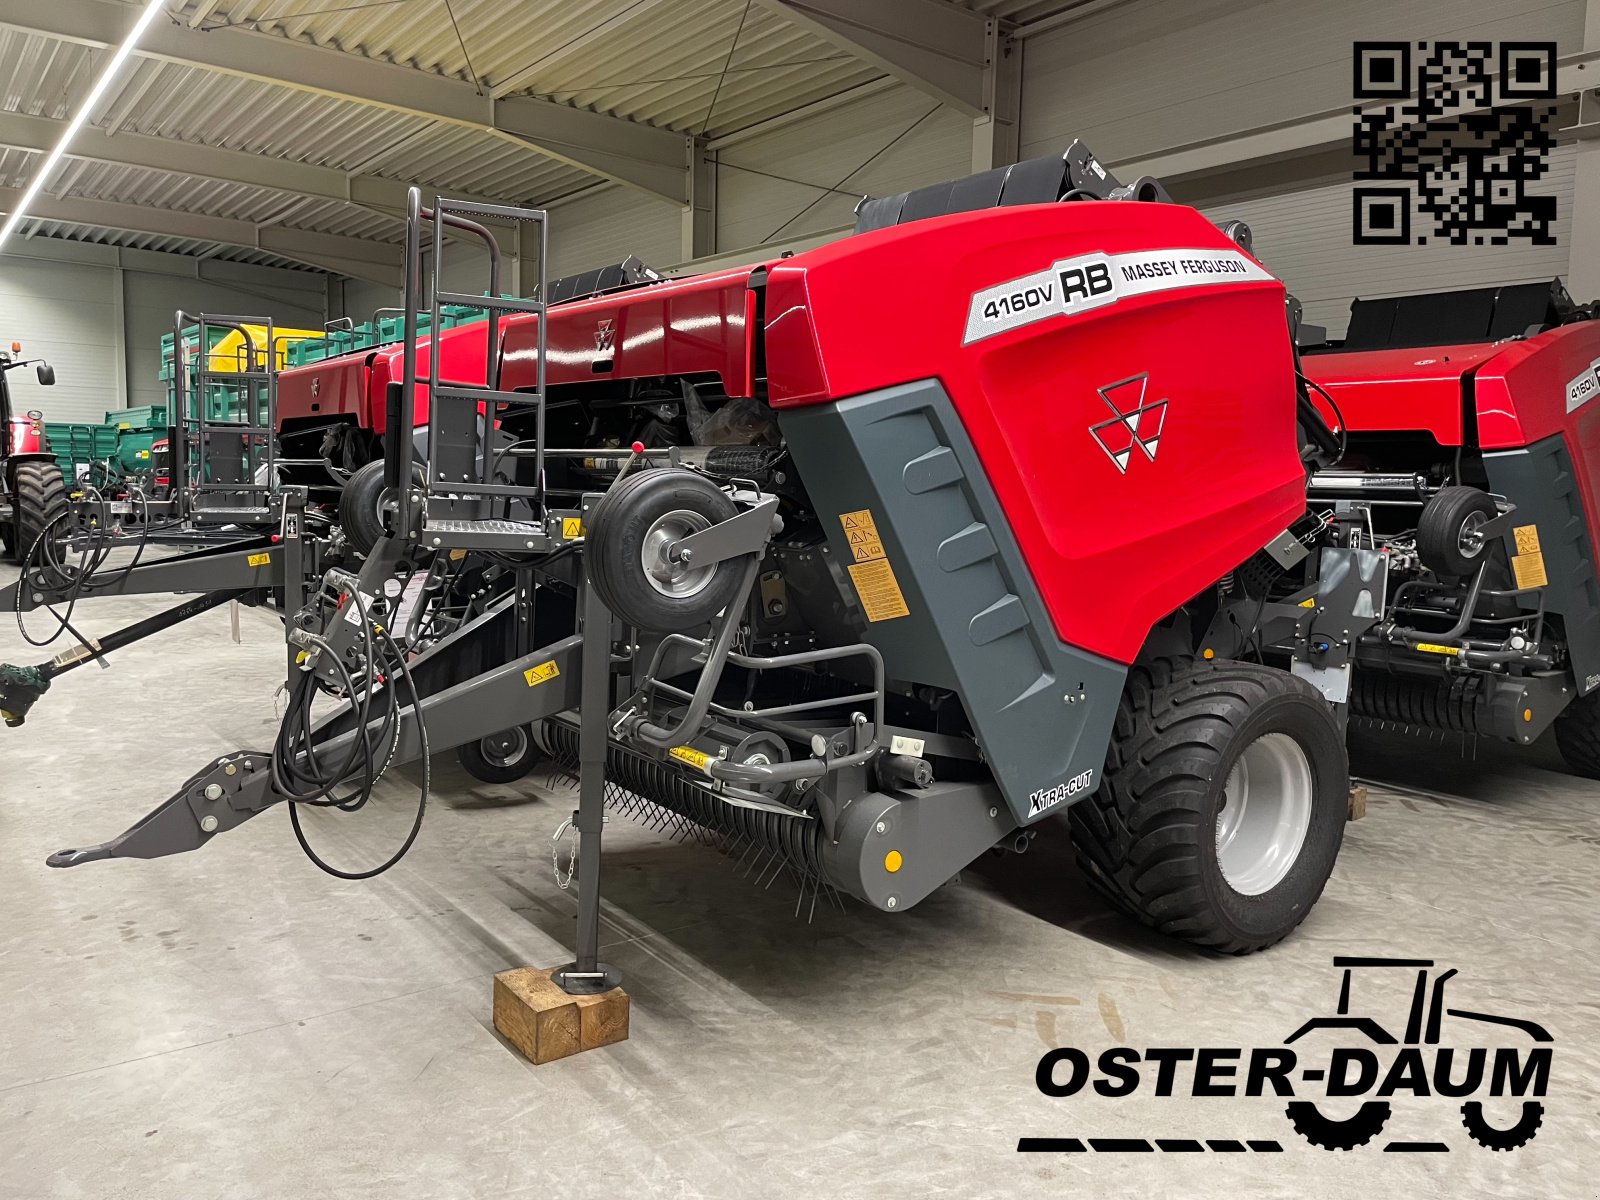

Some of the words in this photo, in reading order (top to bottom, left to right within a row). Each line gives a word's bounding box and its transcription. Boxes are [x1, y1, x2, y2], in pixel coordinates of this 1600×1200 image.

[983, 283, 1053, 319] 4160V
[1059, 263, 1113, 303] RB
[1121, 260, 1178, 282] MASSEY
[1180, 259, 1247, 274] FERGUSON
[1571, 376, 1595, 399] 4160V
[1029, 769, 1092, 816] XTRA-CUT
